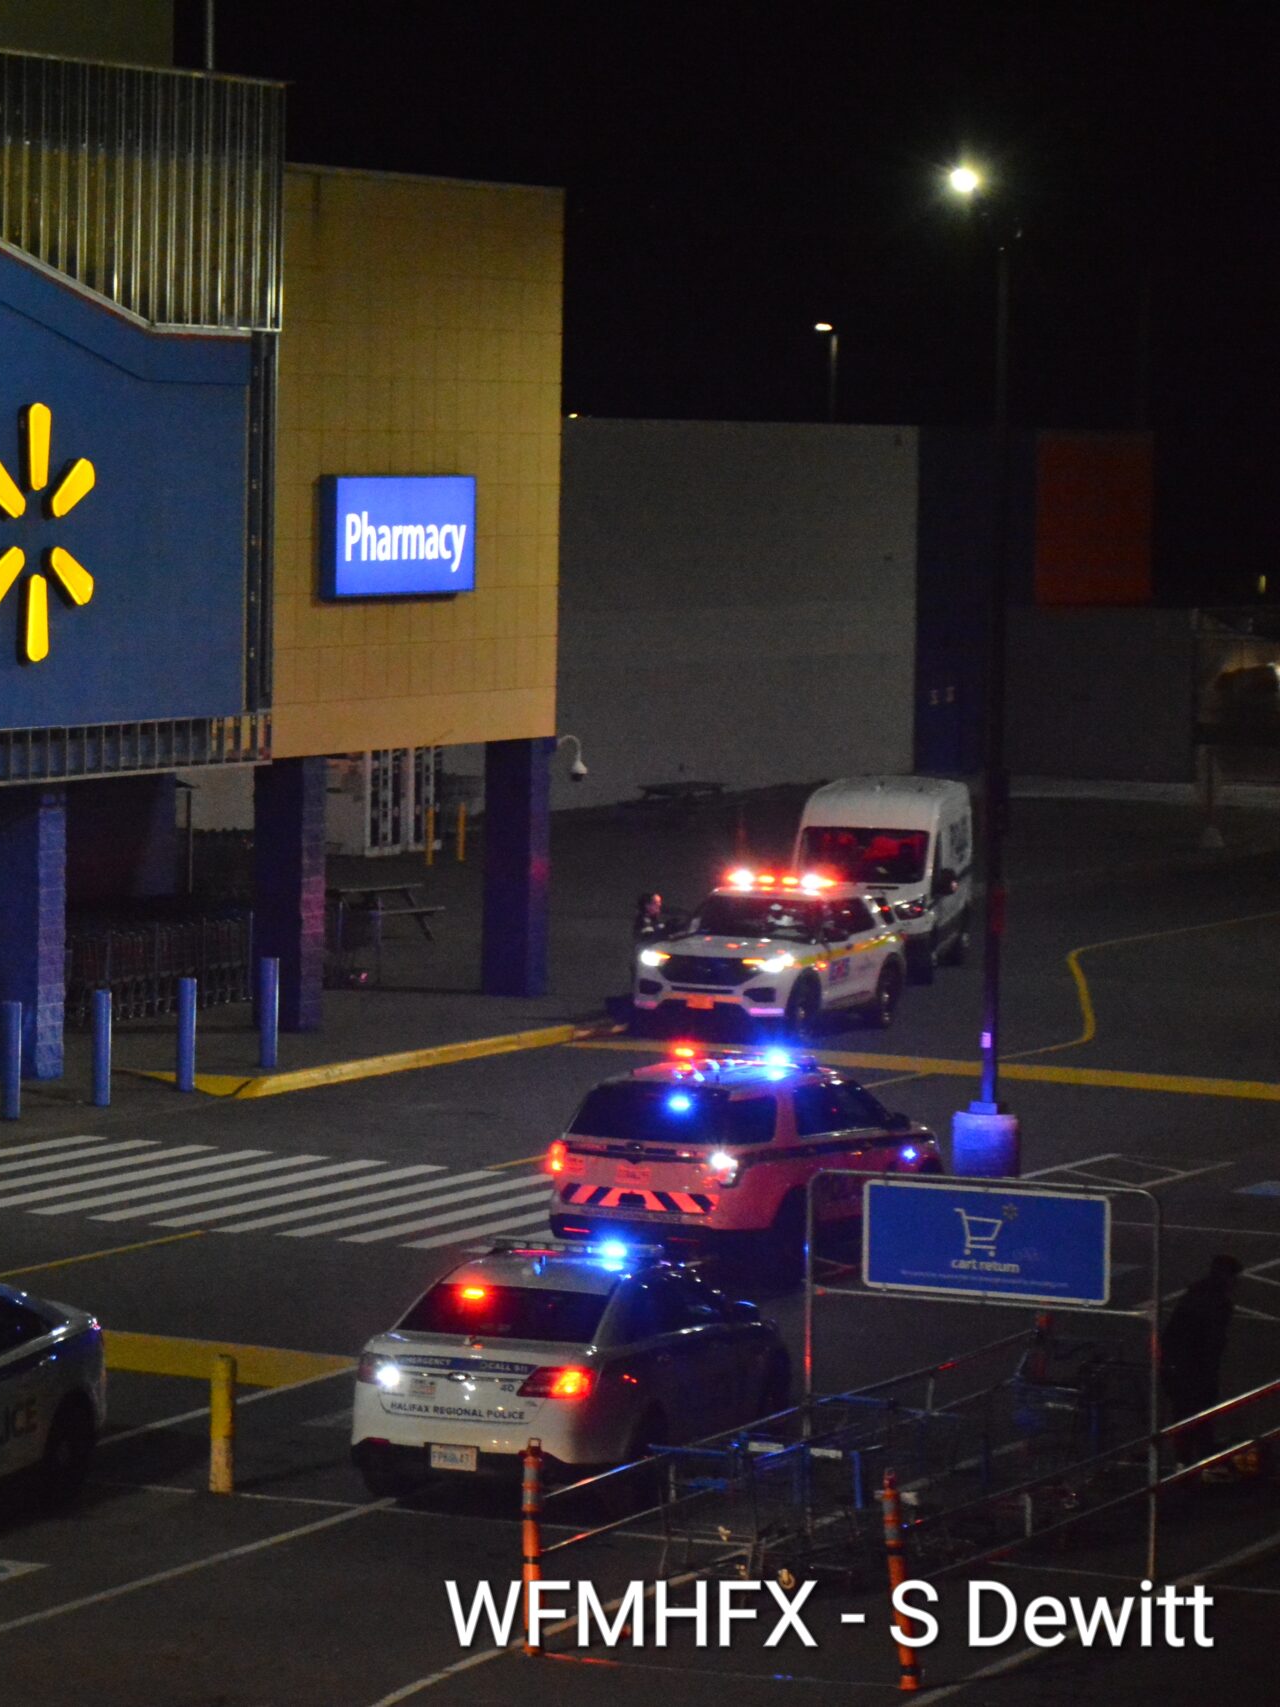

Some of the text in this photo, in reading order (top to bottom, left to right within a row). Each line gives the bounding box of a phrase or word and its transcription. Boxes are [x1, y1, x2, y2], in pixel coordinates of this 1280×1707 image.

[344, 510, 468, 573] Pharmacy
[951, 1259, 1020, 1273] cart return
[401, 1356, 452, 1367] ERGENCY
[487, 1361, 511, 1371] CALL
[390, 1402, 525, 1420] HALIFAX REGIONAL POLICE
